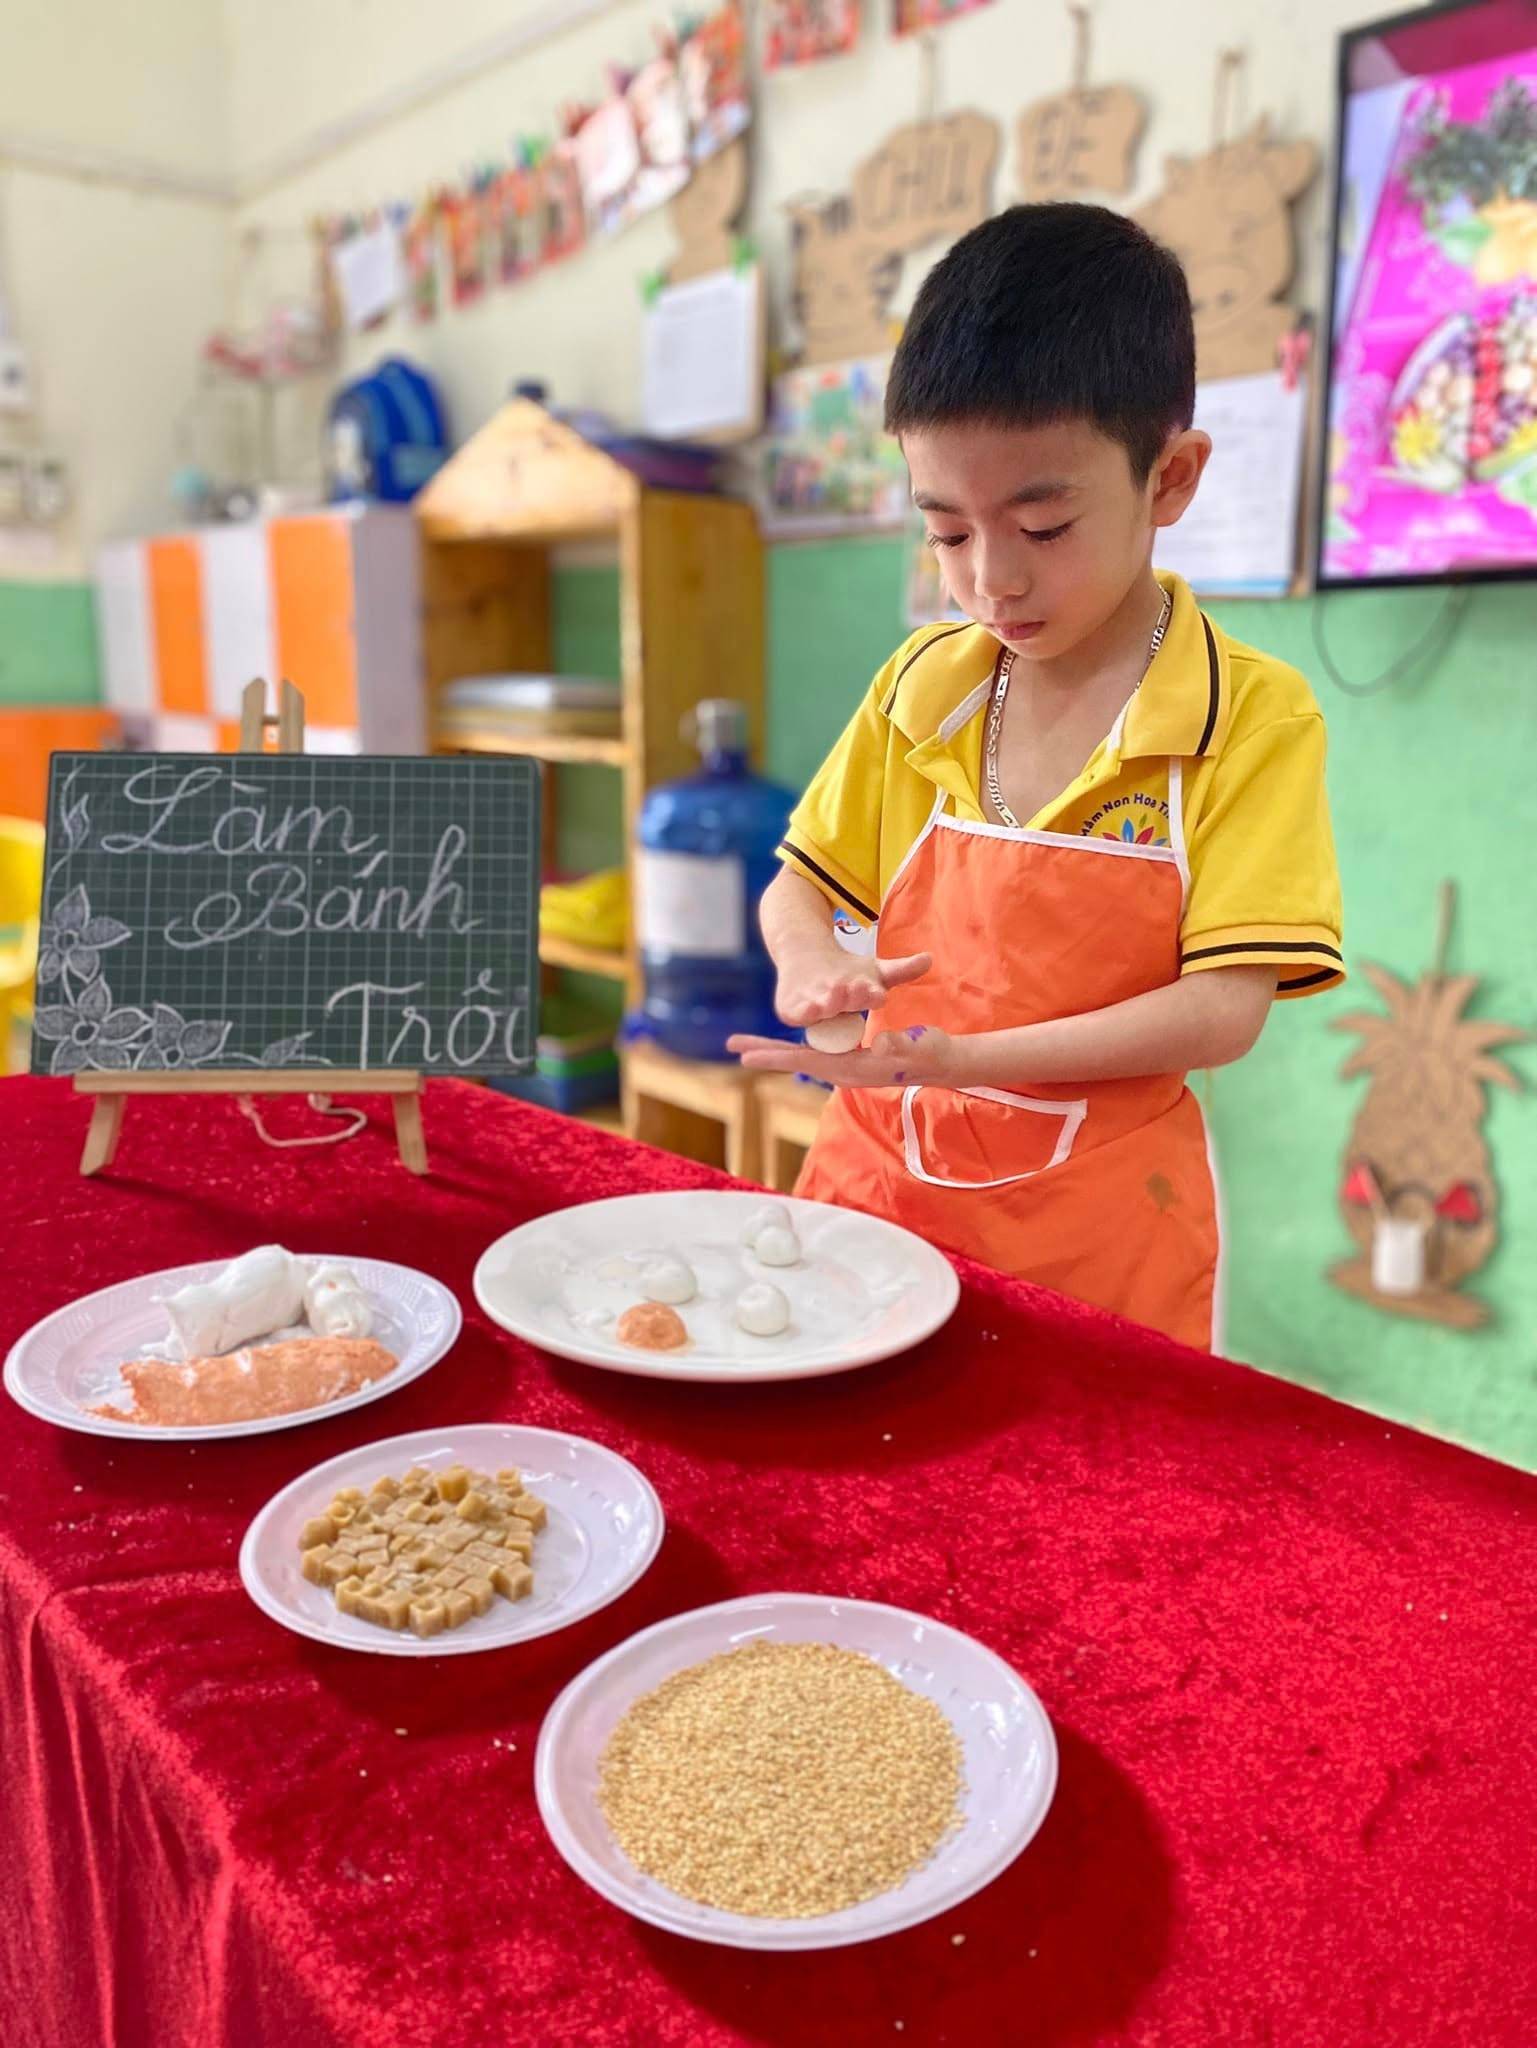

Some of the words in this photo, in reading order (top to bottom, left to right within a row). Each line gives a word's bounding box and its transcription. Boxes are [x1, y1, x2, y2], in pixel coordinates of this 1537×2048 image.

[101, 764, 378, 855] Làm
[1102, 796, 1130, 813] Non
[1134, 793, 1157, 808] Hoa
[164, 824, 484, 949] Bánh
[325, 967, 533, 1070] Trôi
